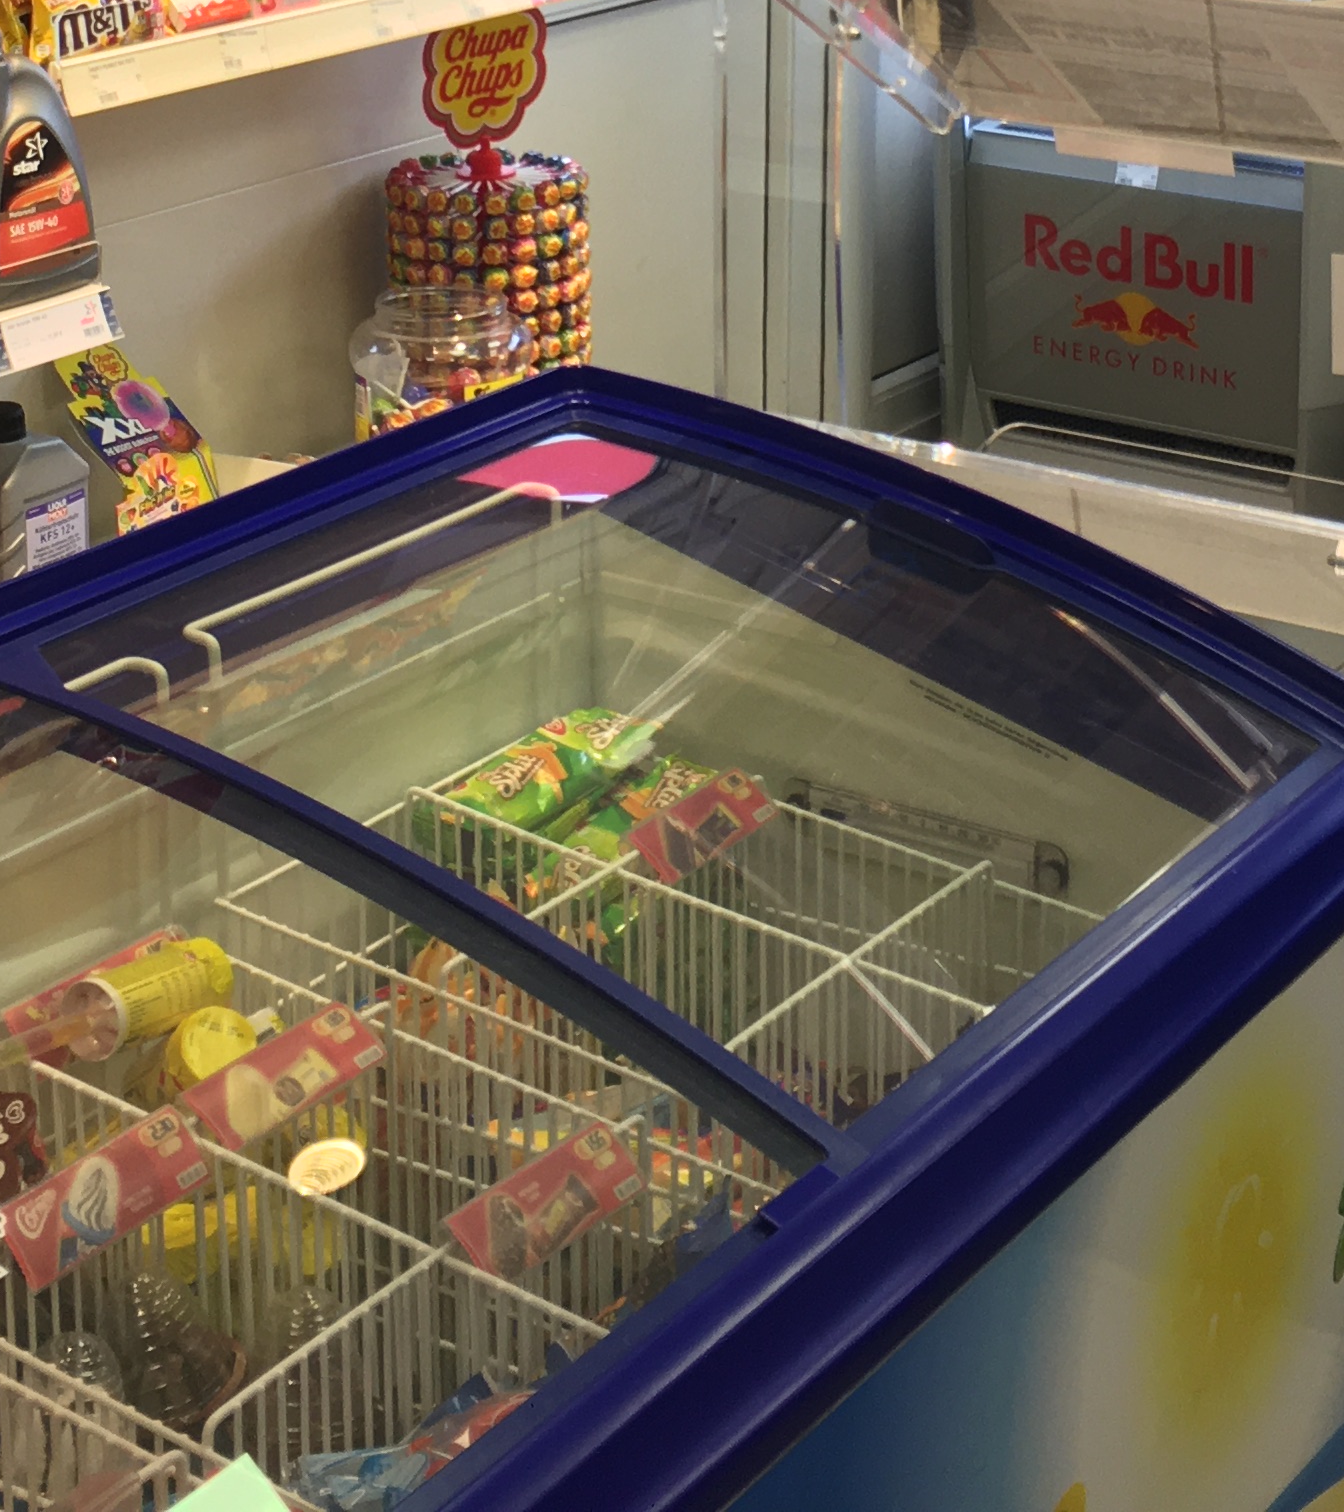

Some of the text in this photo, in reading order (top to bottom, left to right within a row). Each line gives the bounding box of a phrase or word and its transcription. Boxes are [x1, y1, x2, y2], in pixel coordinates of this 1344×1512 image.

[444, 22, 528, 66] Chupa
[438, 54, 525, 118] Chups
[12, 159, 41, 176] star
[9, 224, 26, 238] SAE
[1022, 212, 1255, 305] Red Bull
[1032, 335, 1238, 390] ENERGY DRINK
[86, 414, 153, 446] XXL
